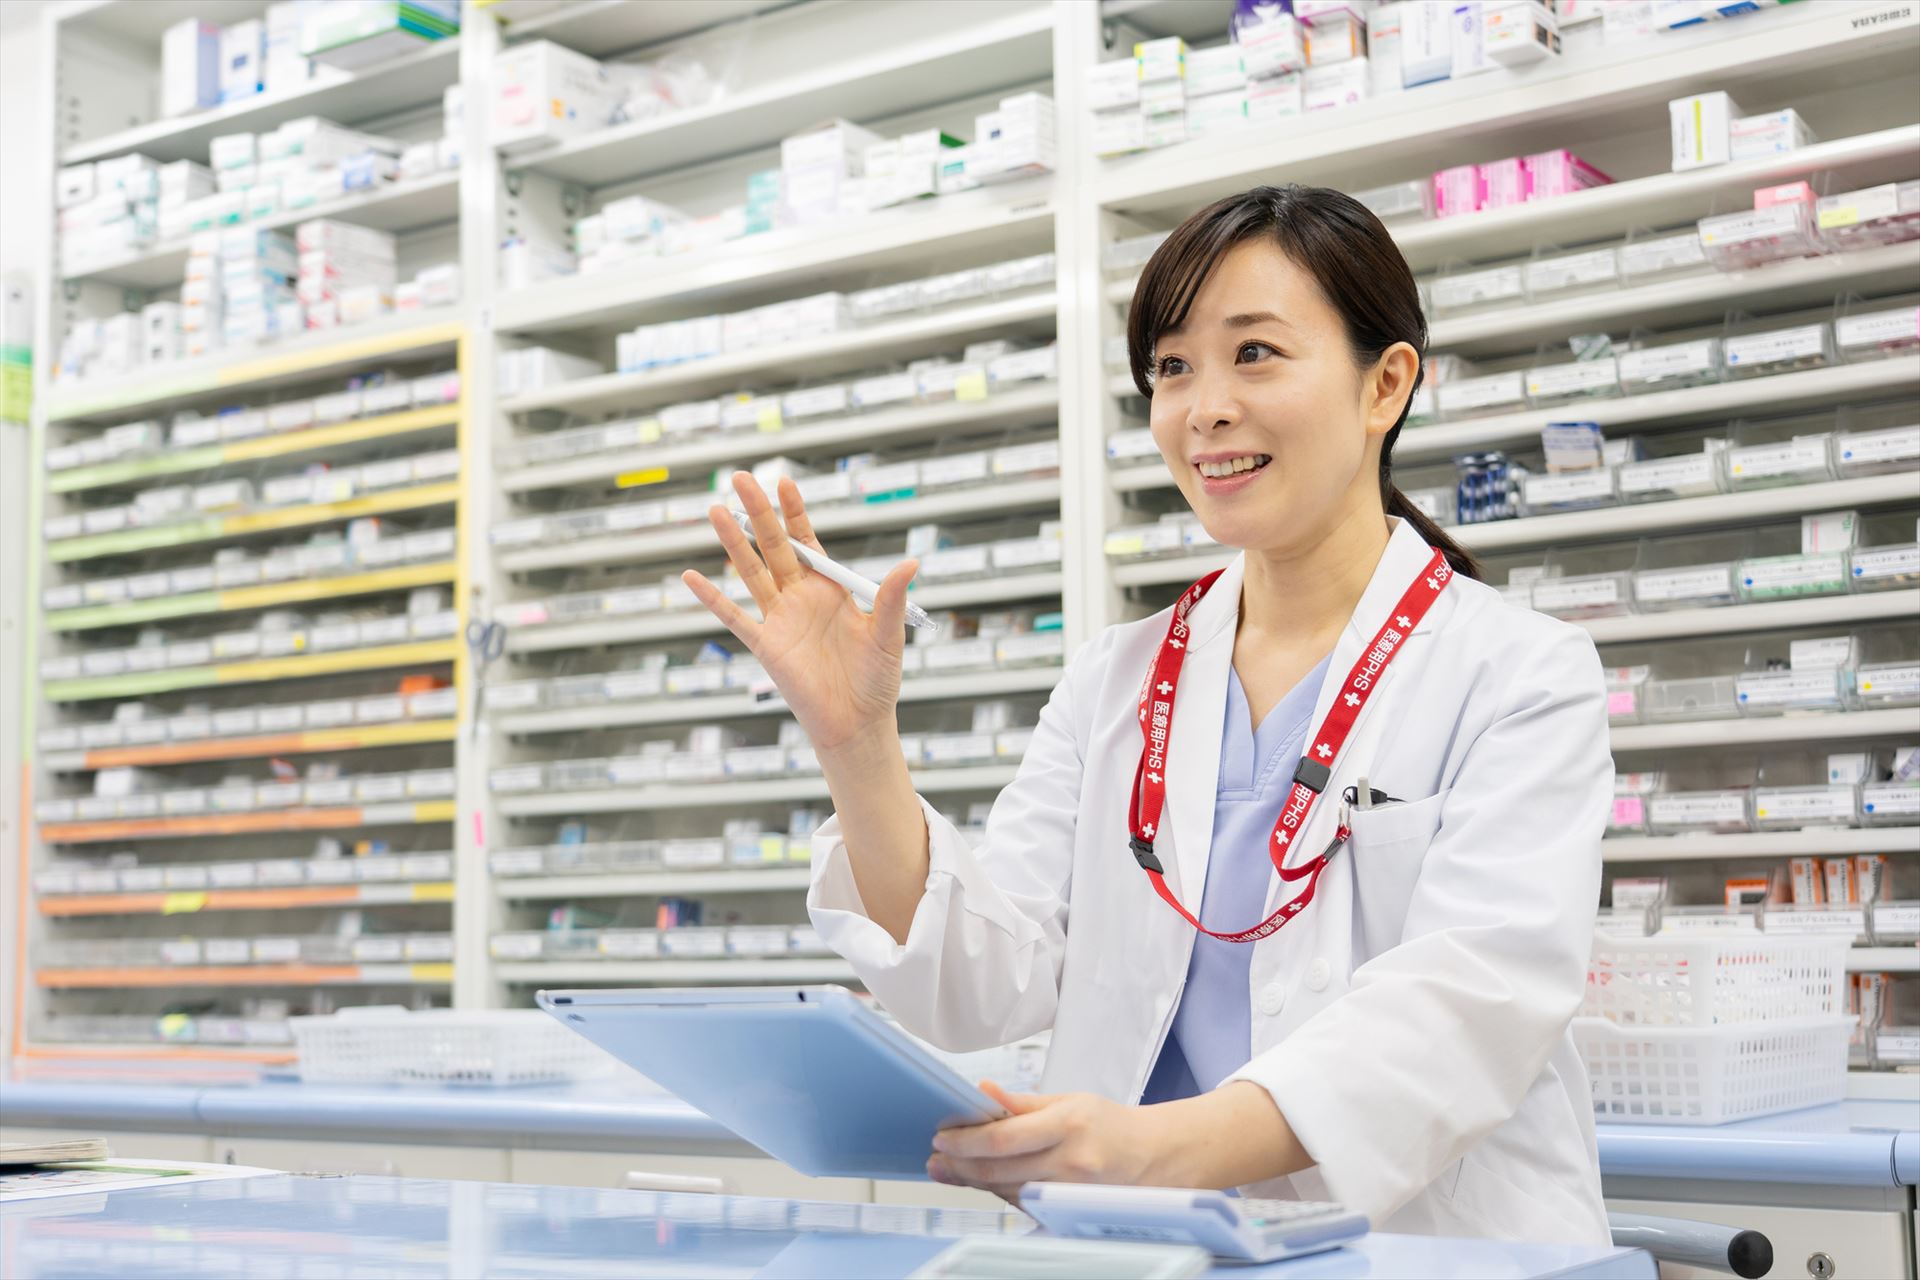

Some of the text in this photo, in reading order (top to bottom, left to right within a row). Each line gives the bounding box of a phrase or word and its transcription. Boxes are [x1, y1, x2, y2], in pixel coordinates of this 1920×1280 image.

[1353, 628, 1402, 691] 医療用PHS
[1148, 700, 1170, 769] 医療用PHS
